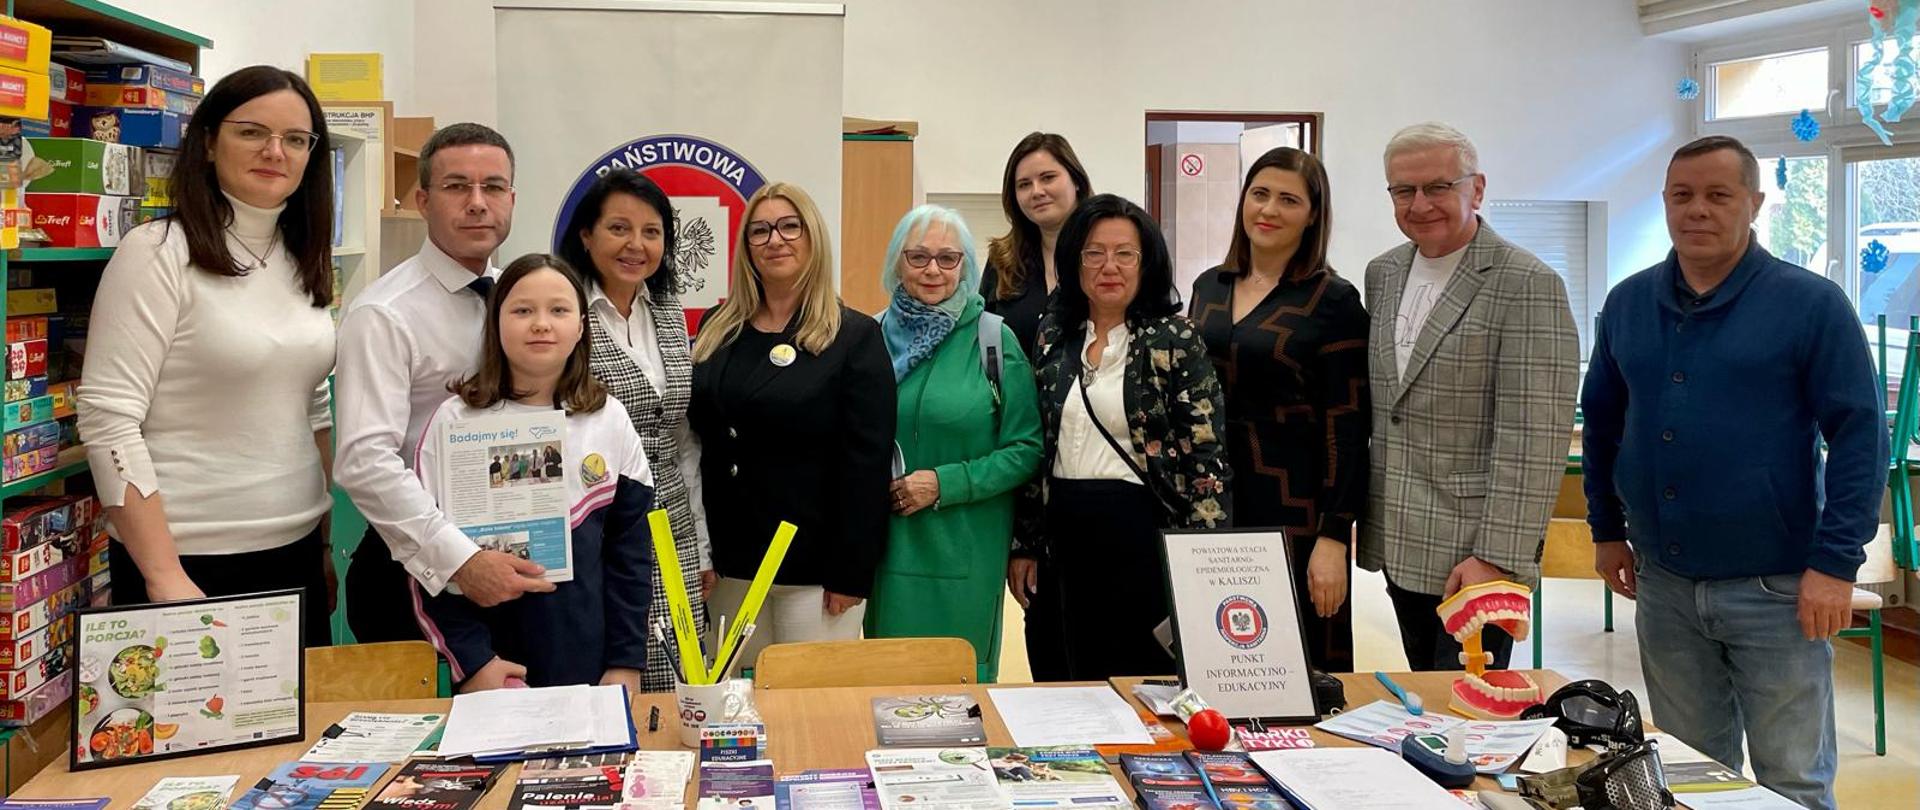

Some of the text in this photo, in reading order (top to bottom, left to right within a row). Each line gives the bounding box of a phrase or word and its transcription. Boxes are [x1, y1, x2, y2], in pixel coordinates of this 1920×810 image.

[595, 142, 746, 186] PAŃSTWOWA
[46, 215, 71, 226] Trefl
[449, 431, 498, 444] Badajmy
[501, 428, 519, 439] się!
[1191, 545, 1268, 555] POWIATOWA STACJA
[1195, 565, 1270, 575] EPIDEMIOLOGICZNA
[1218, 575, 1261, 586] KALISZU
[86, 619, 128, 632] ILE TO
[85, 629, 146, 644] PORCJA?
[1230, 653, 1265, 664] PUNKT
[1206, 666, 1287, 679] INFORMACYJNO
[1217, 681, 1287, 692] EDUKACYJNY
[1237, 728, 1311, 740] NARKO
[1242, 738, 1297, 748] TYKI
[382, 796, 437, 806] Wiedz
[521, 791, 595, 800] Palenie
